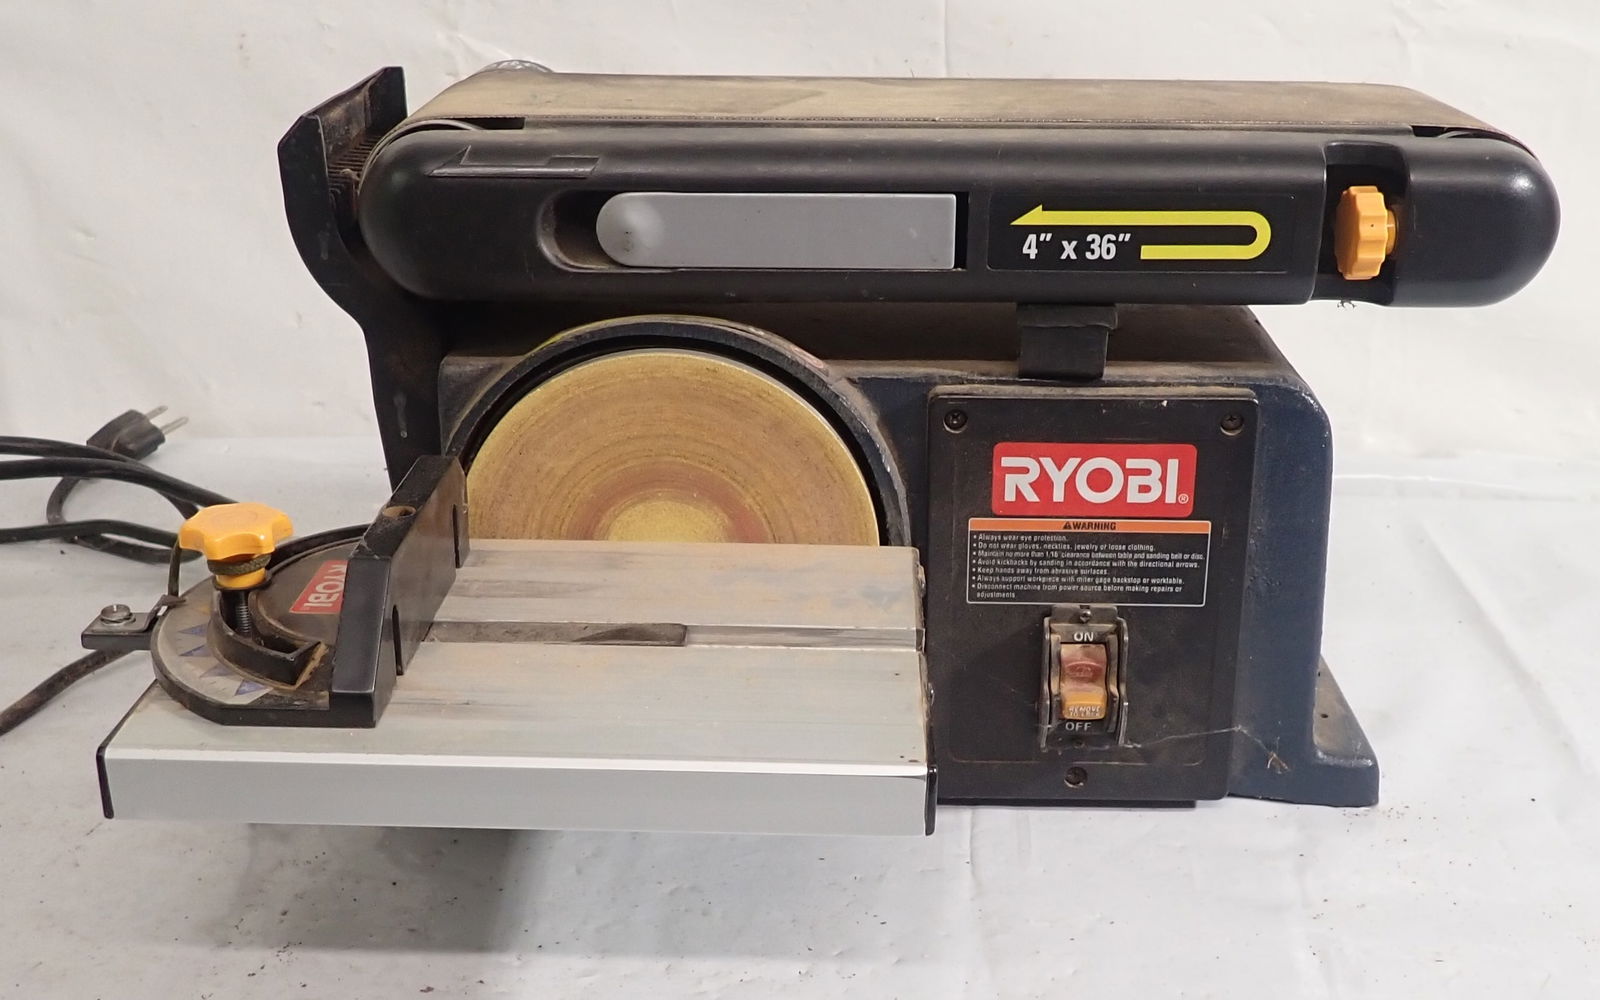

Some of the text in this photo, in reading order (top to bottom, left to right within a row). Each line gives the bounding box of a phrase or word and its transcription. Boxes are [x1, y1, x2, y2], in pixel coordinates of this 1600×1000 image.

[1060, 240, 1078, 260] x
[1072, 521, 1116, 531] WARNING
[978, 534, 1001, 542] Always
[1074, 543, 1098, 551] jewelry
[1127, 544, 1156, 552] clothing.
[1146, 553, 1170, 561] sanding
[1039, 560, 1064, 568] sanding
[977, 575, 1000, 583] Always
[1112, 577, 1141, 585] backstop
[976, 583, 1012, 591] Disconnect
[1125, 585, 1150, 593] making
[1073, 631, 1095, 642] ON
[1065, 721, 1092, 732] OFF
